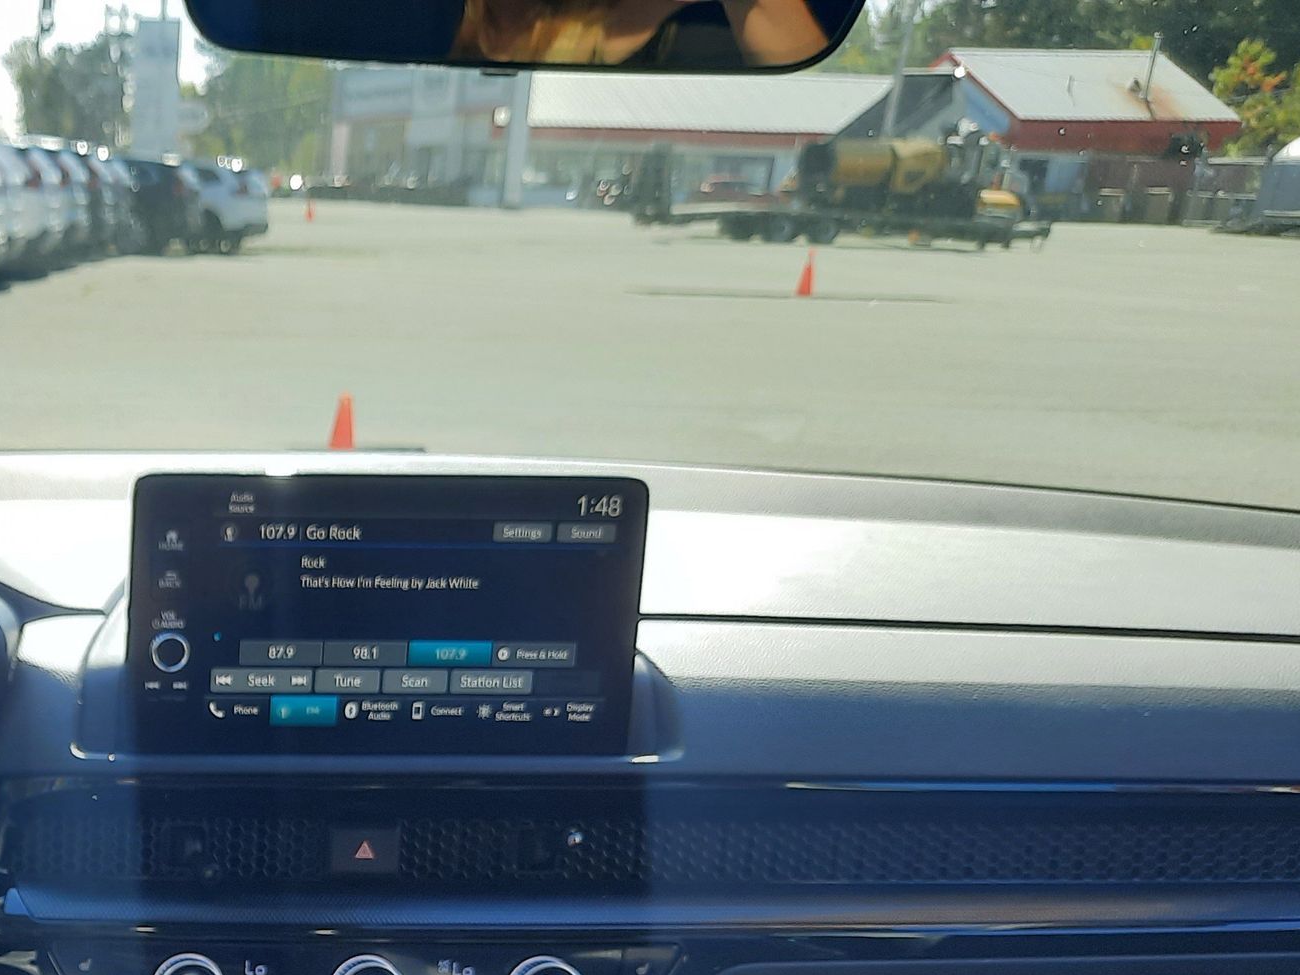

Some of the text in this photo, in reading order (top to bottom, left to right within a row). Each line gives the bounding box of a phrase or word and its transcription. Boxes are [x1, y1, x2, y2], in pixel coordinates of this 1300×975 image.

[577, 494, 623, 517] 1:48
[260, 523, 362, 541] 107.9 Go Rock
[502, 527, 543, 541] Settings
[570, 527, 604, 539] Sound
[300, 555, 326, 569] Rock
[300, 575, 479, 591] That's How I'm Feeling by Jack White
[268, 645, 295, 660] 87.9
[353, 646, 379, 660] 98.1
[435, 647, 467, 661] 107.9
[516, 649, 538, 661] Press
[548, 649, 568, 661] Hold
[247, 675, 275, 688] Seek
[334, 675, 362, 688] Tune
[401, 675, 428, 688] Scan
[459, 675, 523, 689] Station List
[233, 703, 259, 716] Phone
[361, 701, 398, 711] Bluetooth
[430, 705, 463, 717] Connect
[566, 702, 594, 713] Display
